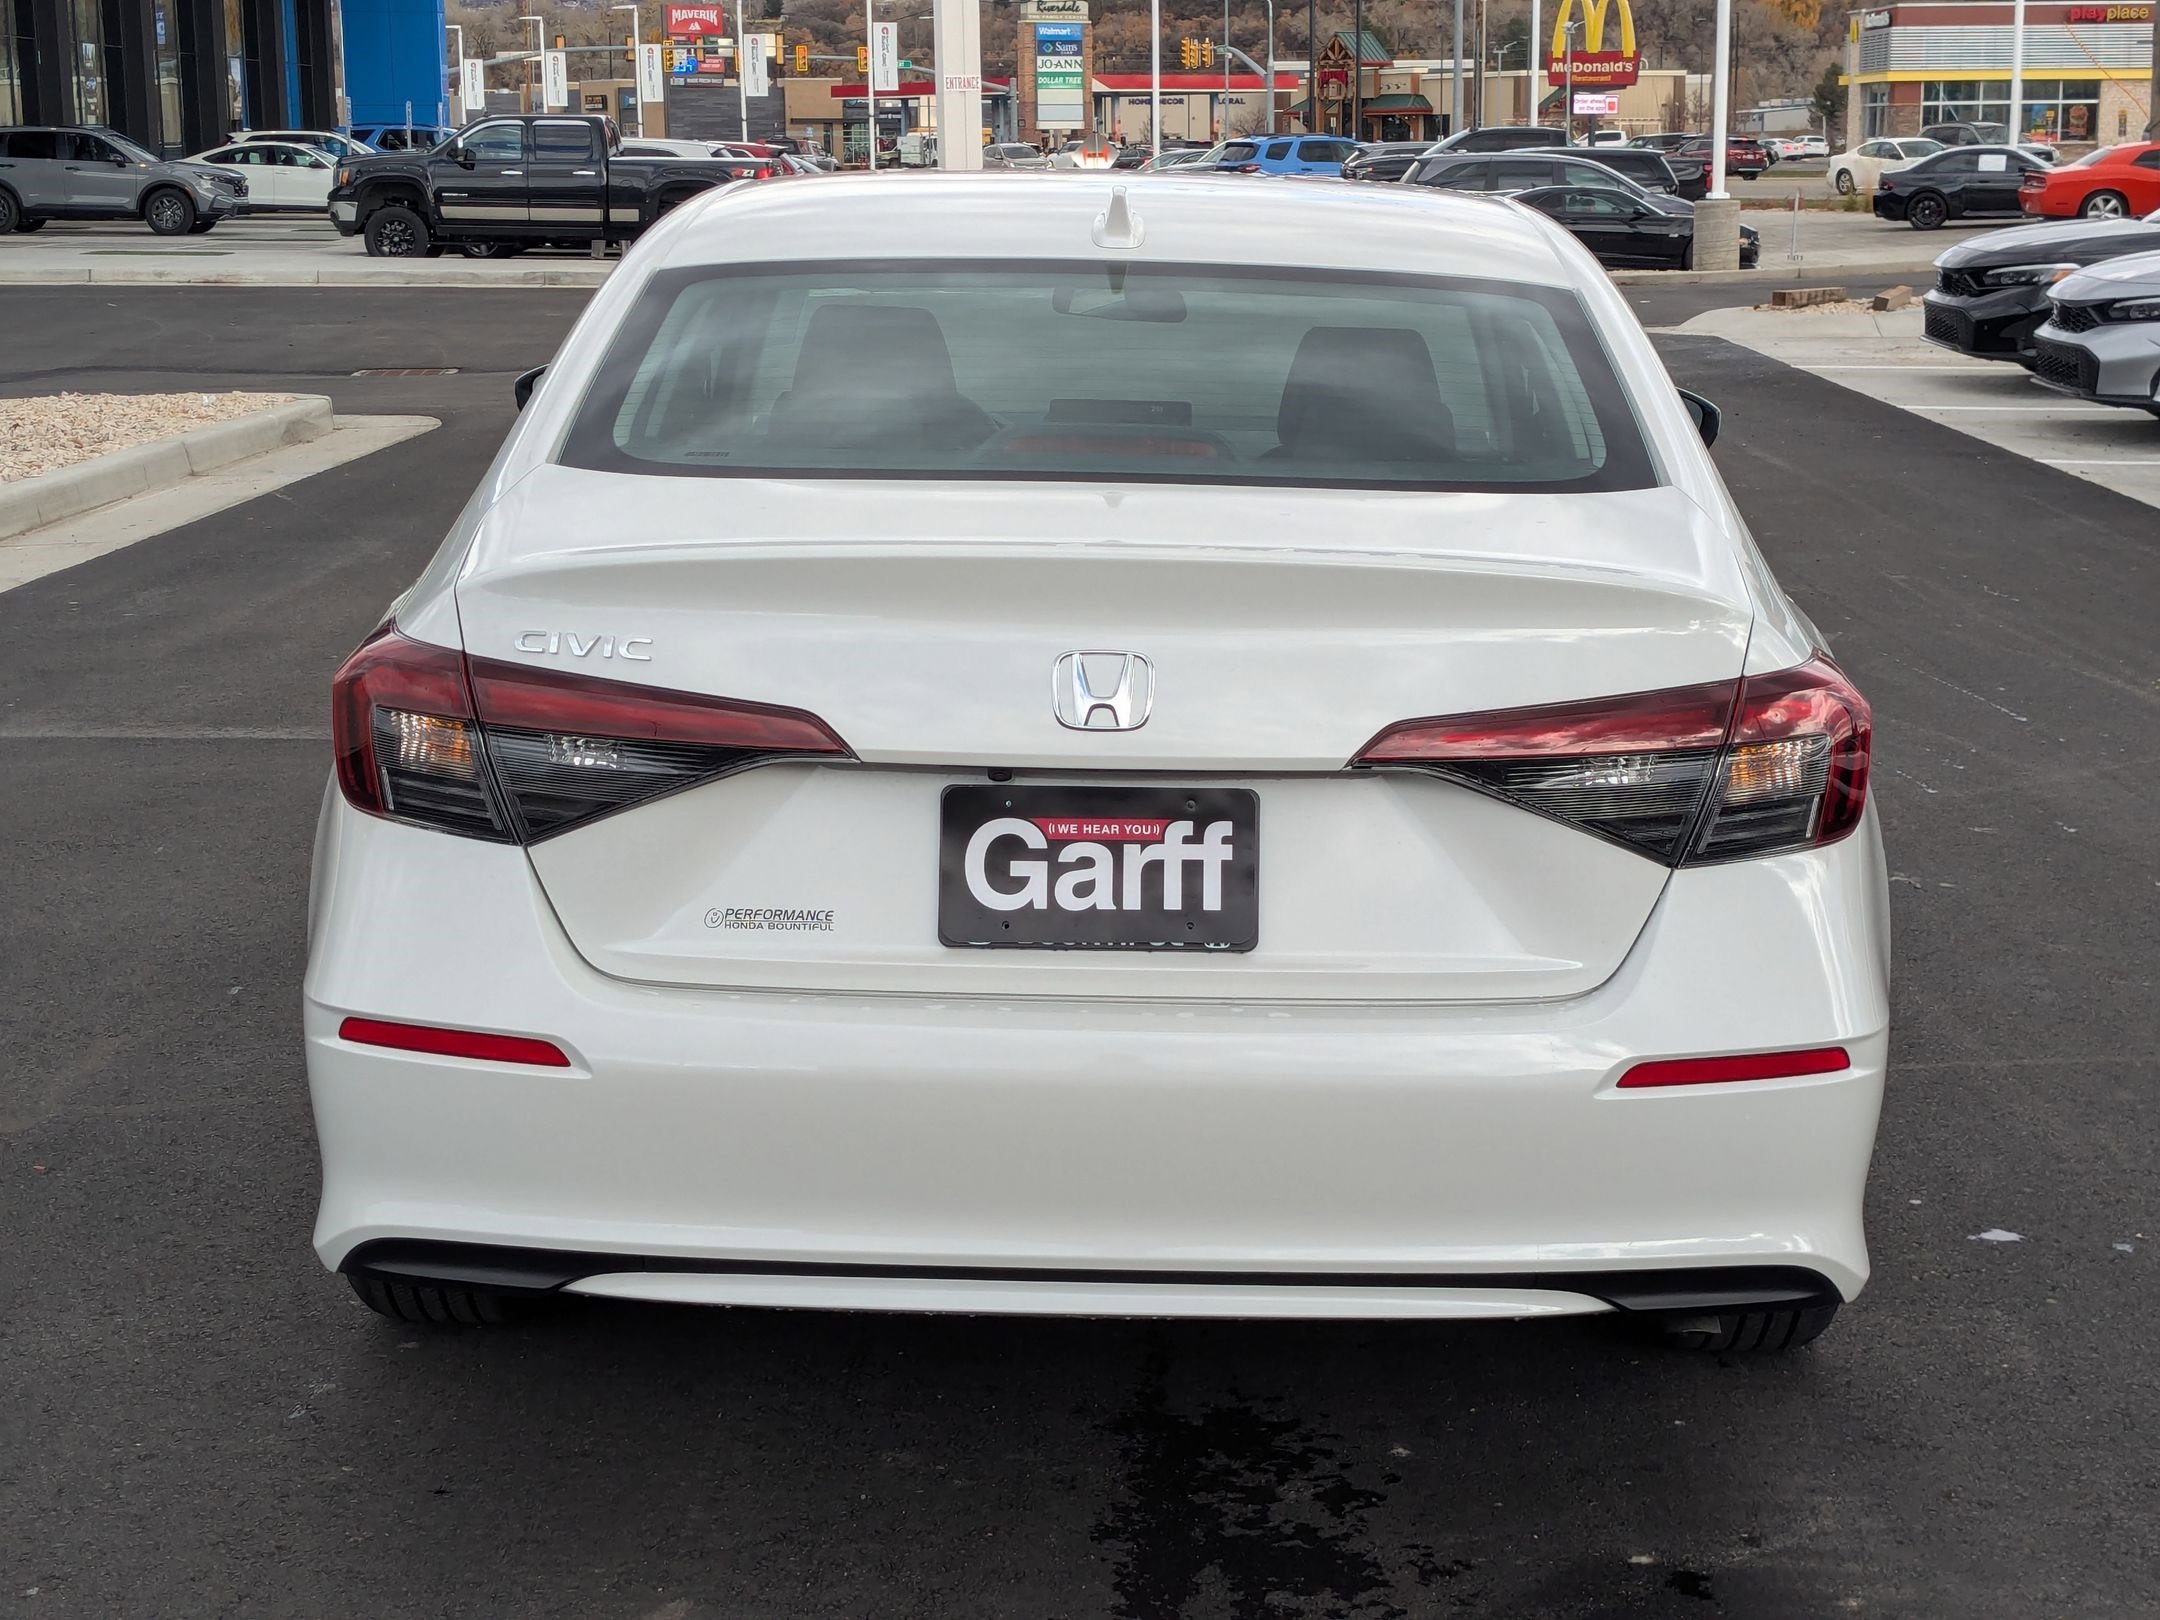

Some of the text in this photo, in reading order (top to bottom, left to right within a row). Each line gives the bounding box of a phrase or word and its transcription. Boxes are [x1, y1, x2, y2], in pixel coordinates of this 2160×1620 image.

[1036, 0, 1081, 13] Riverdale
[671, 9, 718, 26] MAVERIK
[2070, 5, 2149, 22] playplace
[1038, 27, 1071, 35] Walmart
[1551, 61, 1633, 73] McDonald's
[945, 76, 980, 90] ENTRANCE
[1038, 76, 1082, 84] DOLLAR TREE
[514, 629, 653, 661] CIVIC
[1083, 824, 1119, 834] HEAR
[964, 817, 1233, 911] Garff
[725, 908, 834, 922] PERFORMANCE
[724, 921, 834, 931] HONDA BOUNTIFUL
